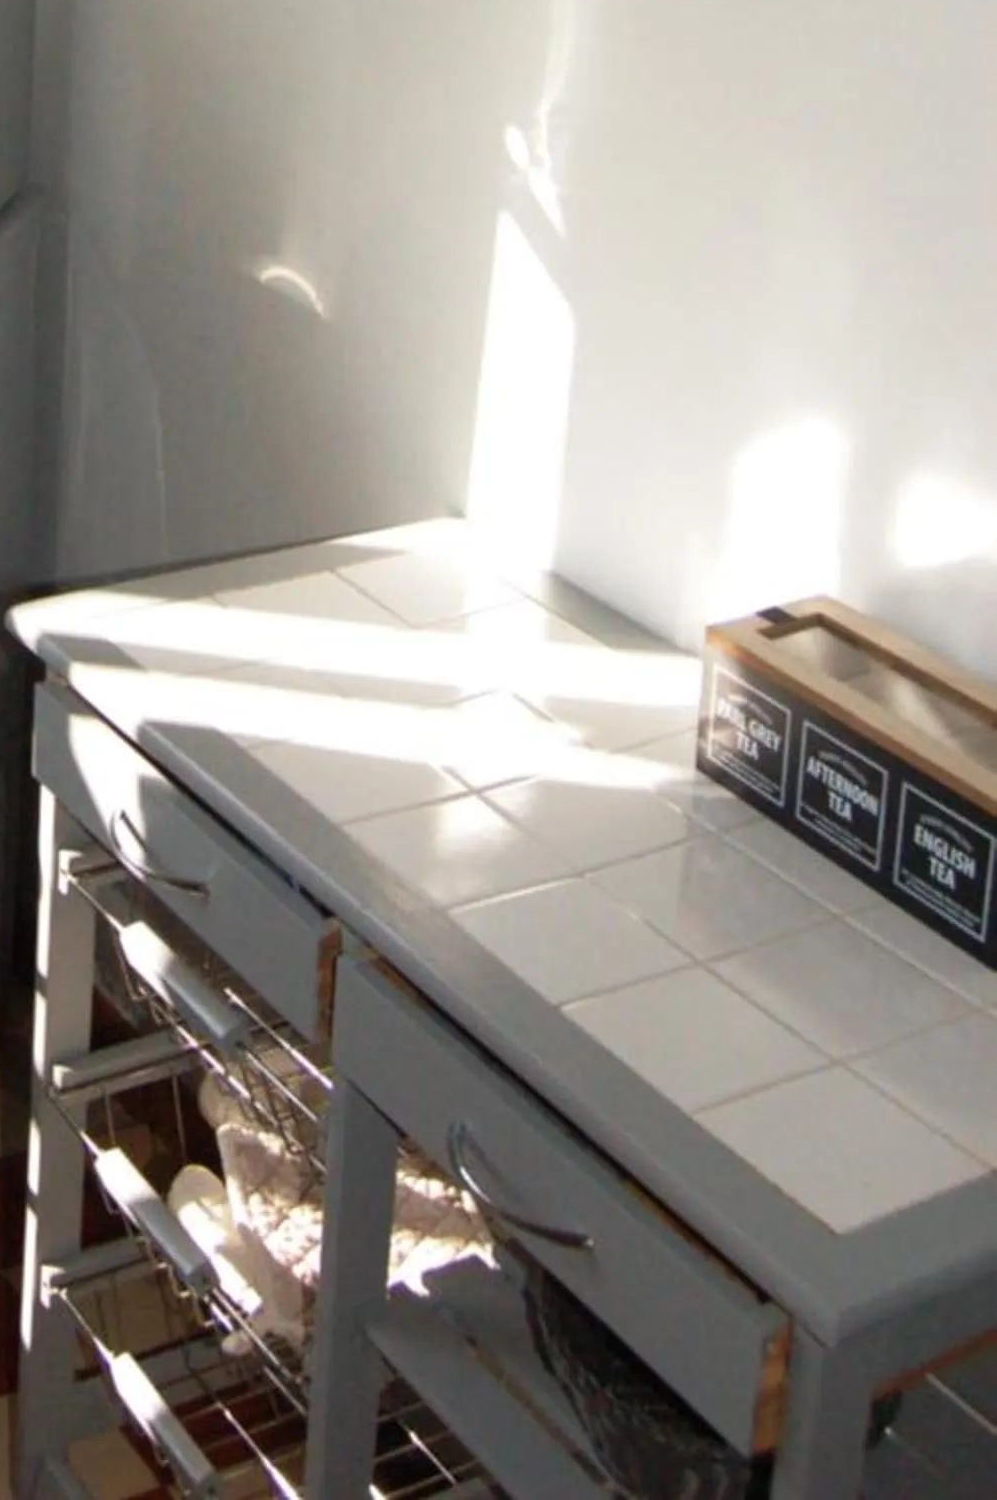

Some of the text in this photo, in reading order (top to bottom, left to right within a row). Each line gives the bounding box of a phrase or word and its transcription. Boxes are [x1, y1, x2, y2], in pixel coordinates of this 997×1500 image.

[736, 731, 760, 761] TEA
[748, 717, 783, 753] GREY
[806, 755, 879, 816] AFTERNOON
[827, 790, 853, 822] TEA
[913, 821, 977, 879] ENGLISH
[928, 856, 956, 891] TEA
